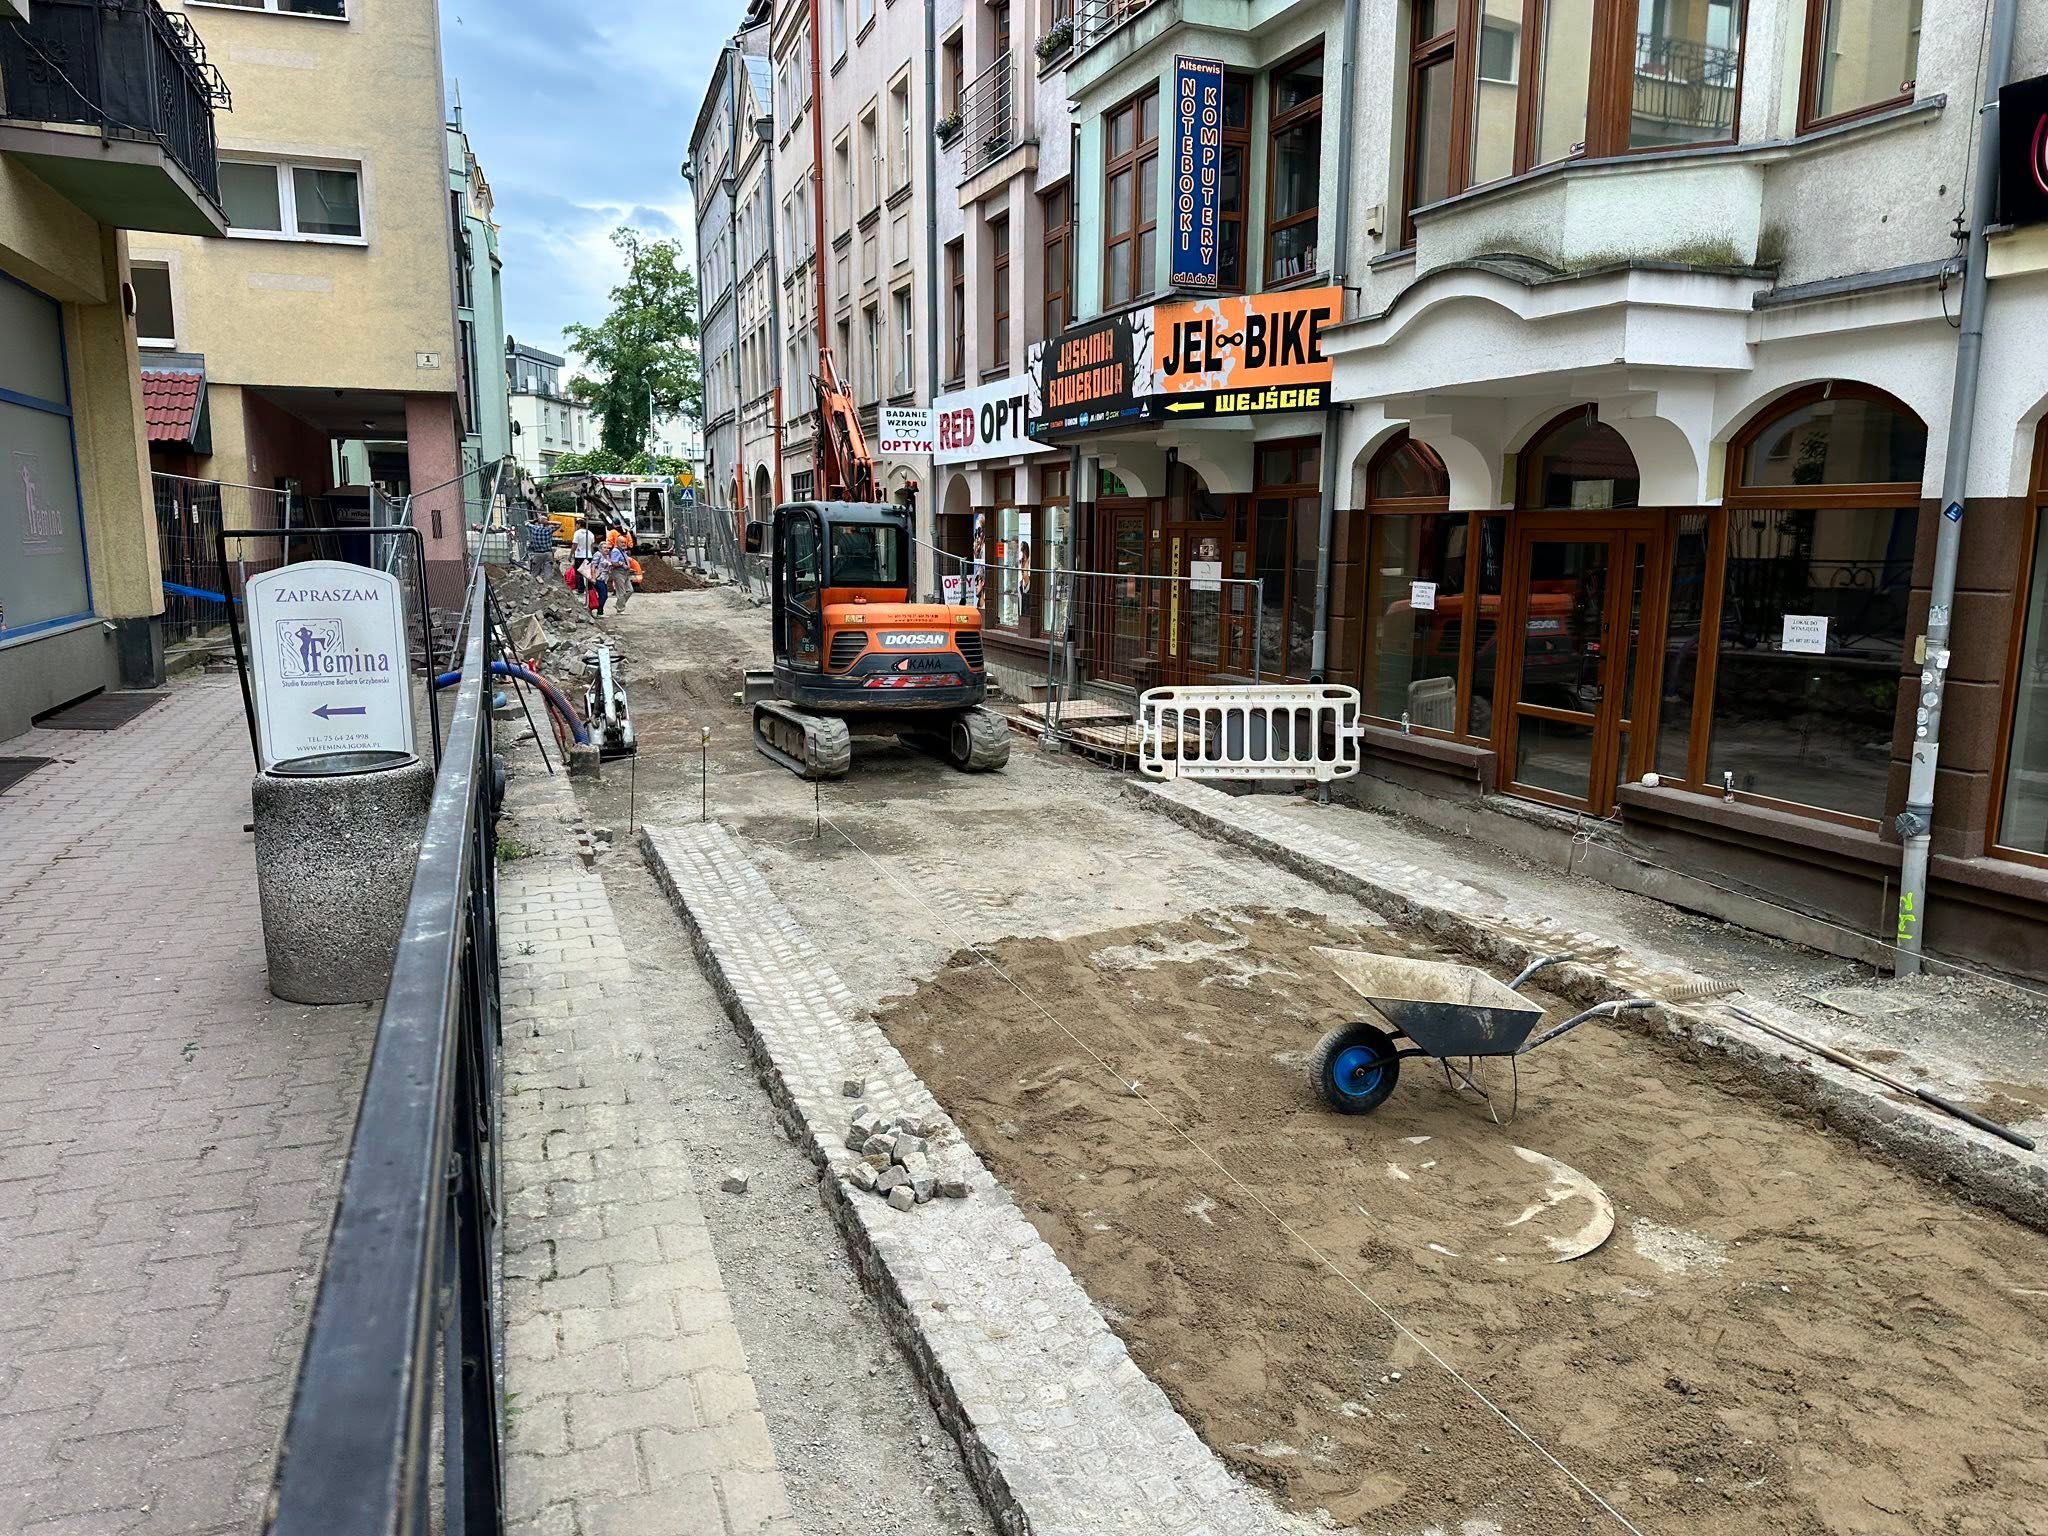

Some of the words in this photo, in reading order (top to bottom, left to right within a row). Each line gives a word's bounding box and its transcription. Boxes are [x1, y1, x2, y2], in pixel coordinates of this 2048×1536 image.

[1179, 60, 1221, 74] Altserwis
[1179, 78, 1196, 250] NOTEBOOKI
[1200, 87, 1218, 265] KOMPUTERY
[1173, 272, 1186, 283] od
[1186, 272, 1195, 283] A
[1195, 273, 1207, 284] do
[1207, 274, 1216, 284] Z
[1162, 319, 1223, 376] JEL
[1245, 307, 1331, 369] BIKE
[1057, 328, 1114, 373] JASKINIA
[425, 355, 431, 363] 1
[1049, 362, 1123, 408] ROWEROWA
[1215, 386, 1320, 412] WEJŚCIE
[886, 410, 928, 419] BADANIE
[939, 408, 976, 450] RED
[881, 440, 933, 452] OPTYK
[275, 588, 380, 602] ZAPRASZAM
[885, 634, 944, 645] DOOSAN
[804, 644, 815, 652] 63
[310, 637, 390, 675] Femina
[909, 658, 942, 670] KAMA
[282, 680, 300, 688] Studio
[300, 677, 336, 688] Kosmetyczne
[336, 677, 358, 685] Barbara
[296, 742, 381, 752] WWW.FEMINA.JGORA.PL
